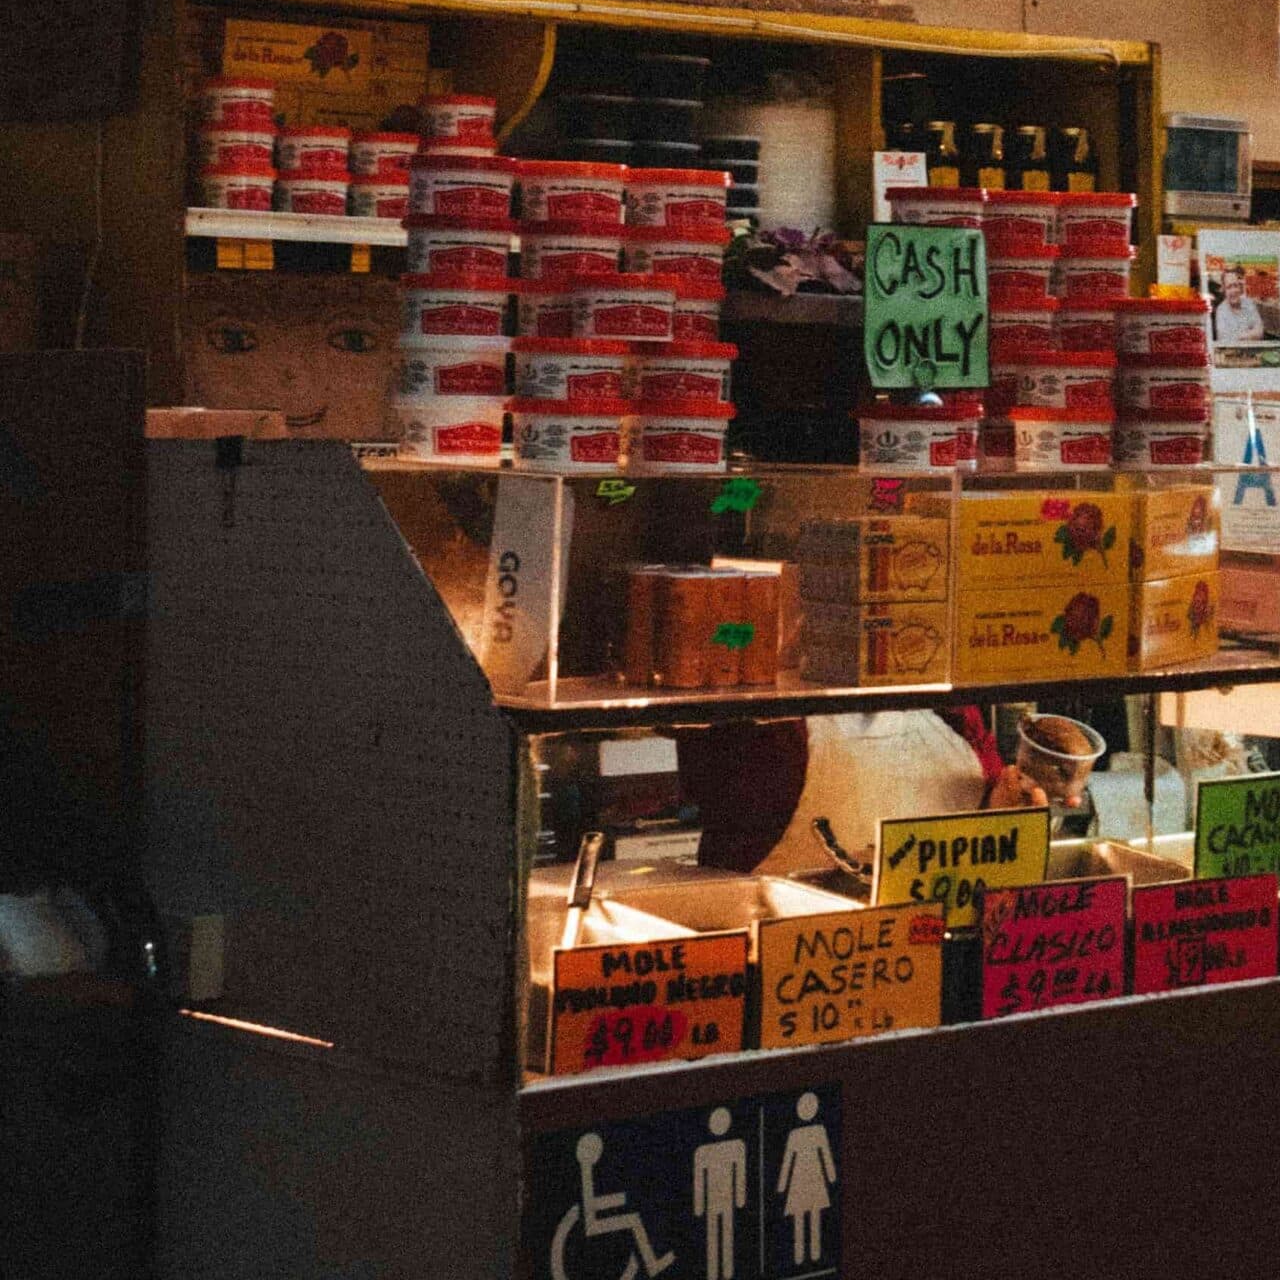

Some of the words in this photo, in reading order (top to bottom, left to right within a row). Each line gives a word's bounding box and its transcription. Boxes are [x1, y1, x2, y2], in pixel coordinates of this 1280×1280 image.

[873, 231, 981, 300] CASH
[876, 312, 984, 377] ONLY
[918, 827, 1019, 873] PIPIAN
[602, 944, 687, 978] MOLE
[794, 918, 897, 964] MOLE
[776, 956, 914, 1004] CASERO
